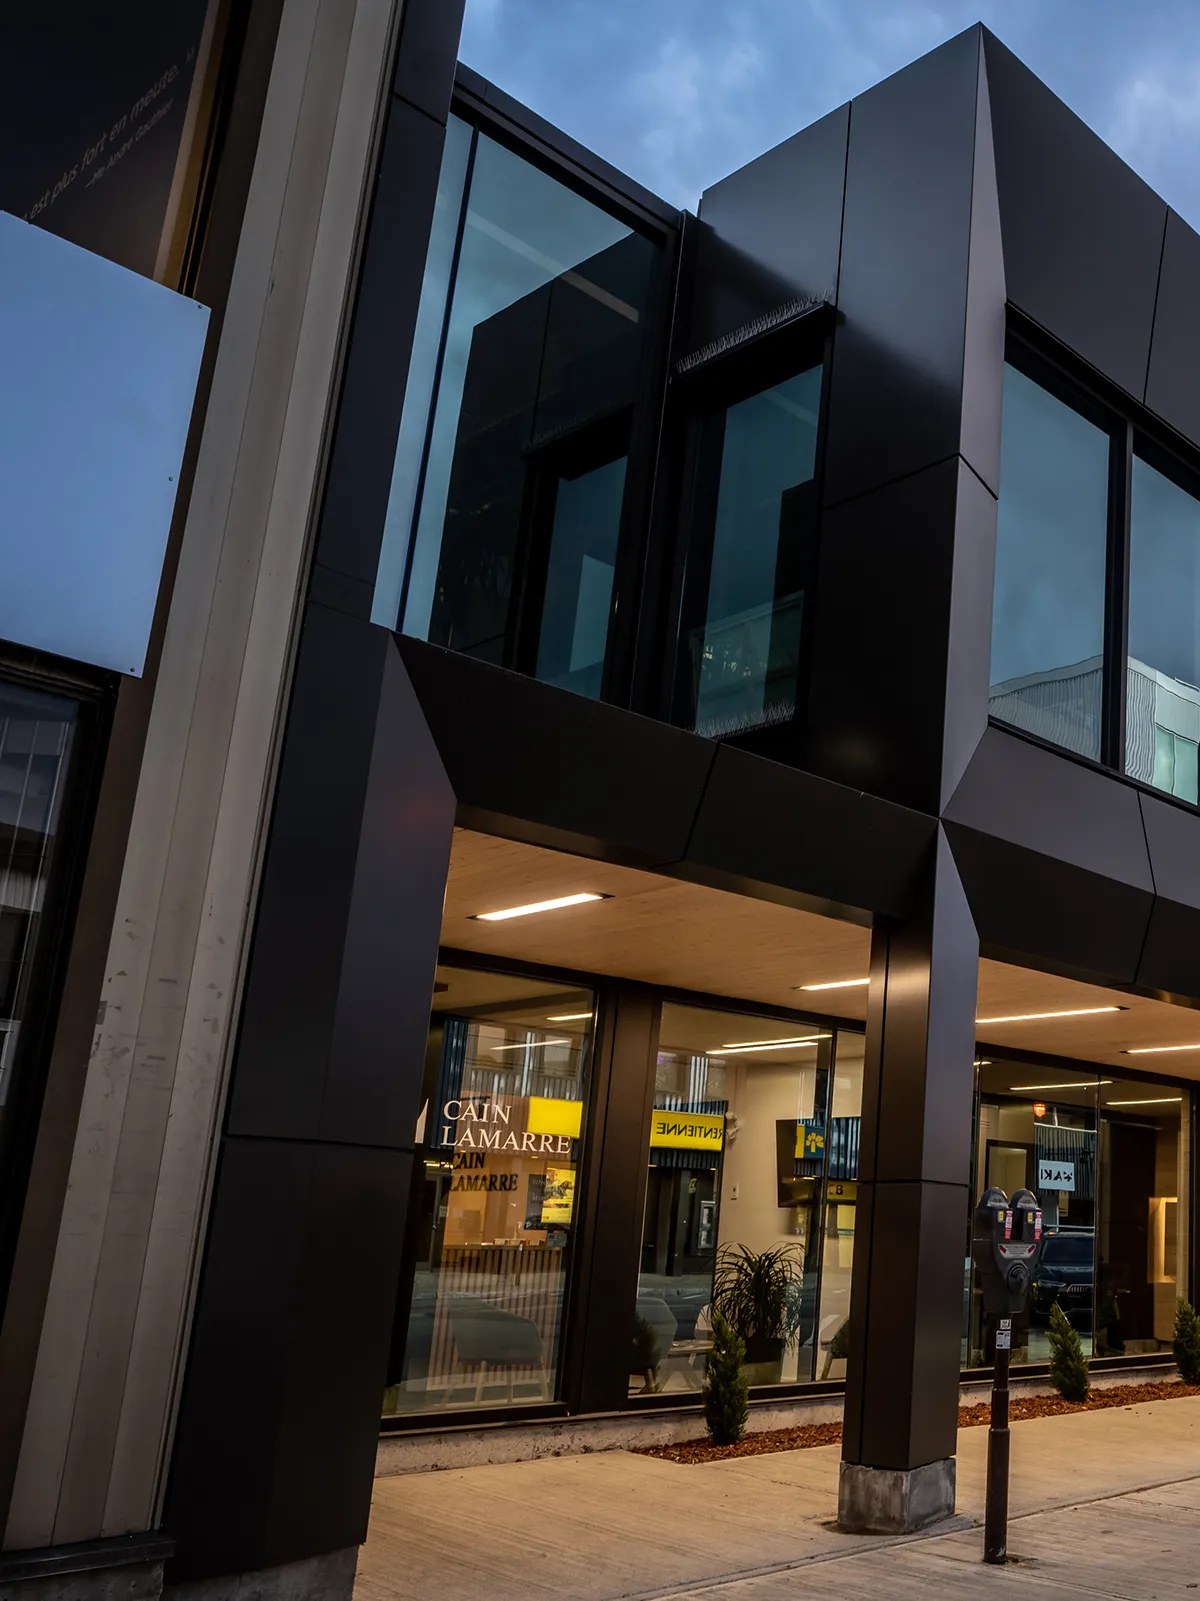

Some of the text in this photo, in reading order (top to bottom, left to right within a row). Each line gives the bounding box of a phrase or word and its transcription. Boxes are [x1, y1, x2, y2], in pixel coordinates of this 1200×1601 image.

[30, 189, 51, 220] est
[51, 163, 79, 205] plus
[80, 131, 107, 172] fort
[109, 115, 128, 142] en
[443, 1099, 512, 1125] CAIN
[440, 1125, 572, 1154] LAMARRE
